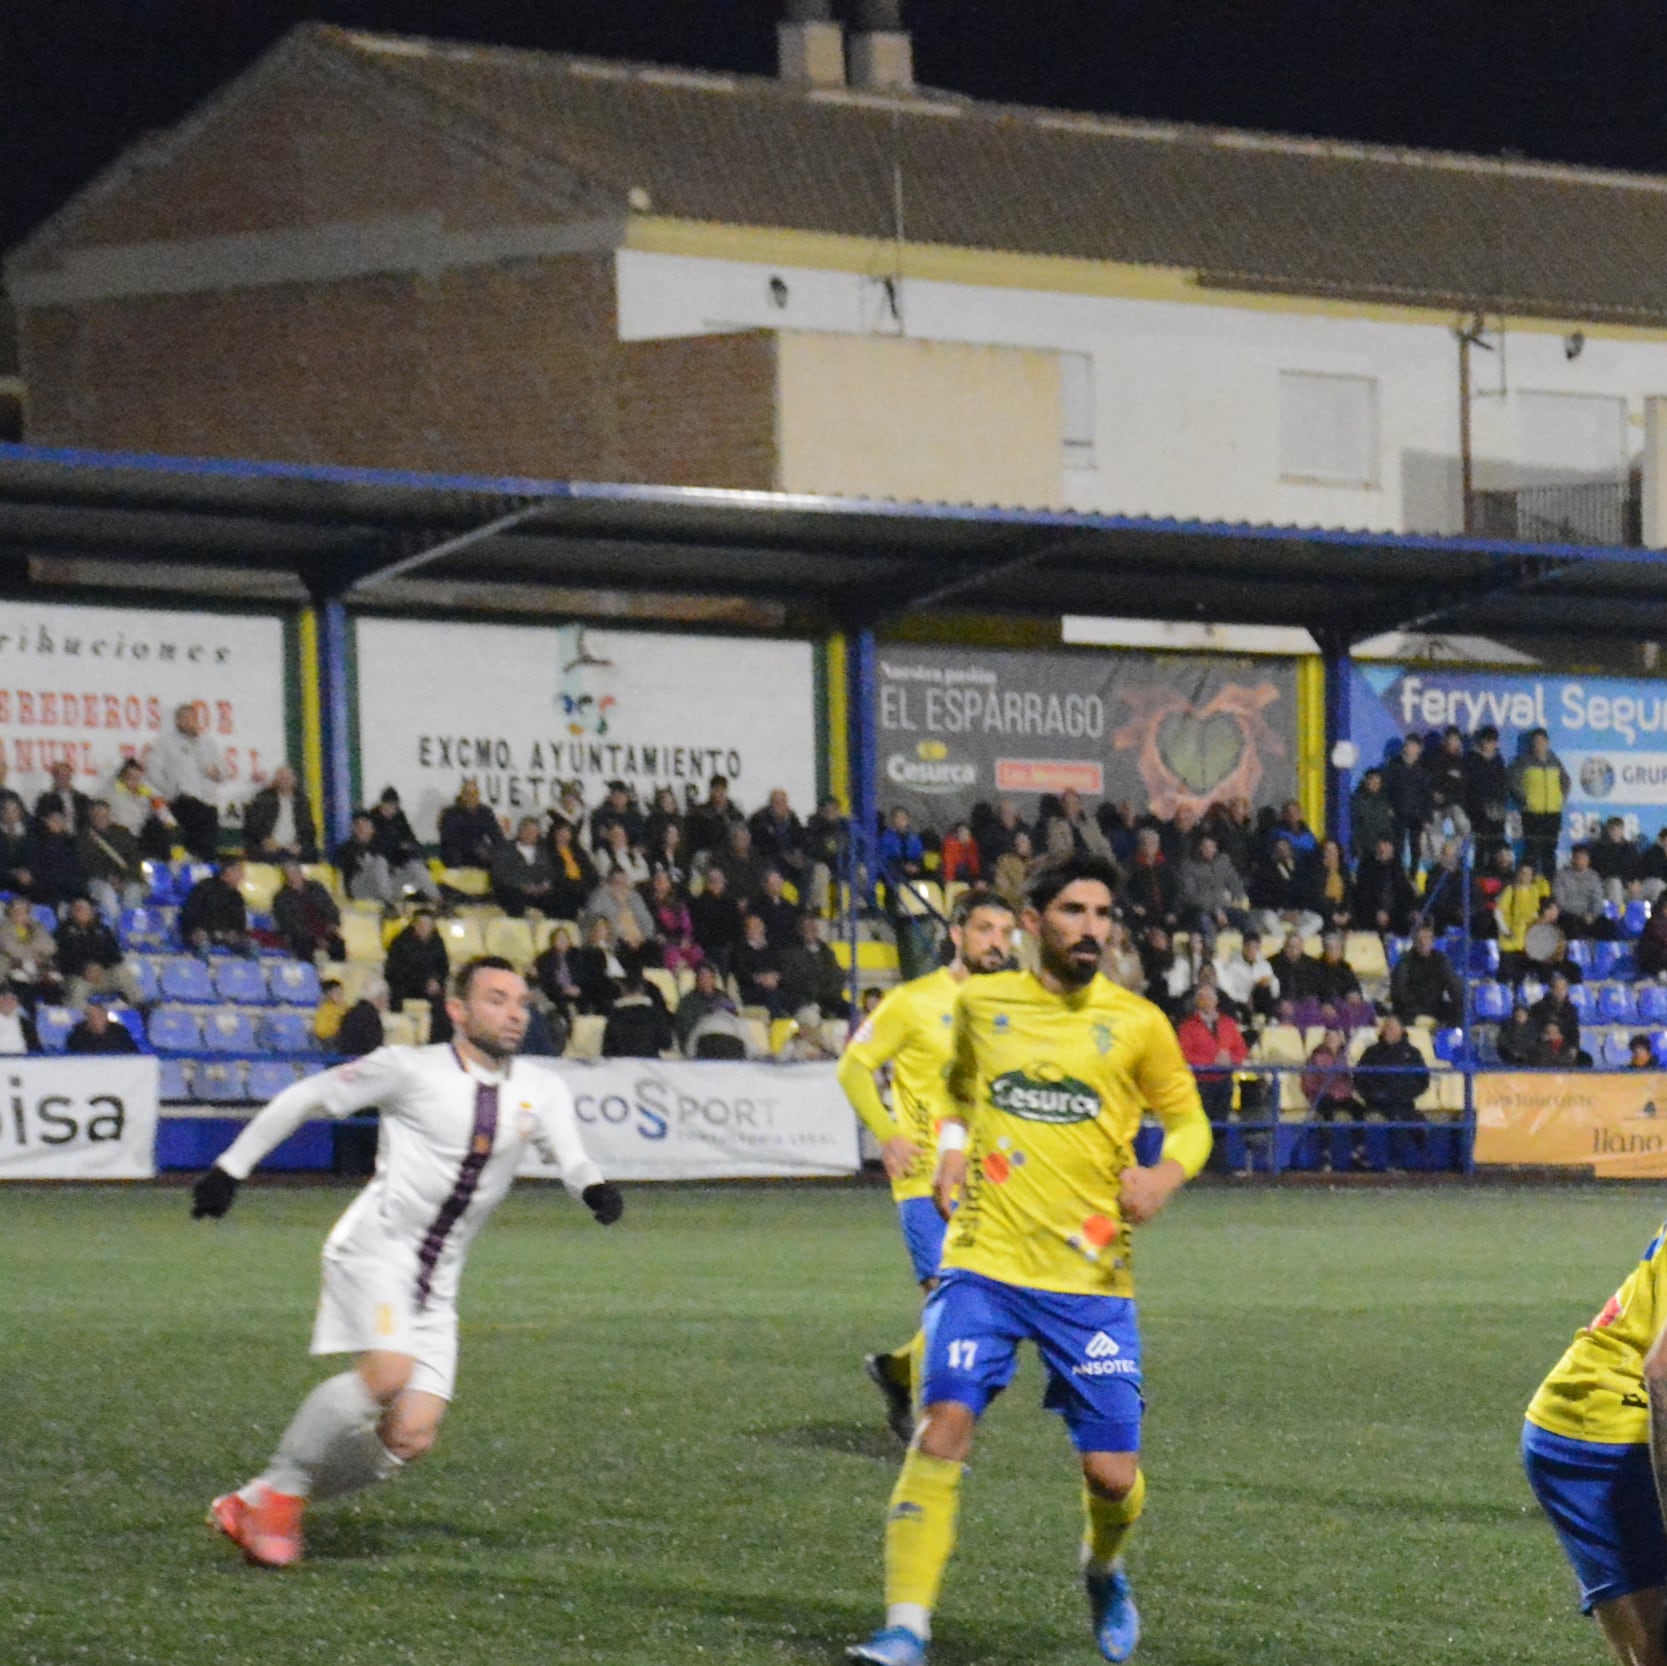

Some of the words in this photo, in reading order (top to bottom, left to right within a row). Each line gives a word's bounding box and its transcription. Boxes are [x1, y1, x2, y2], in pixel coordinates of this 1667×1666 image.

[881, 685, 917, 731] EL
[1400, 677, 1548, 733] feryval
[530, 739, 742, 779] AYUNTAMIENTO
[948, 1338, 978, 1371] 17
